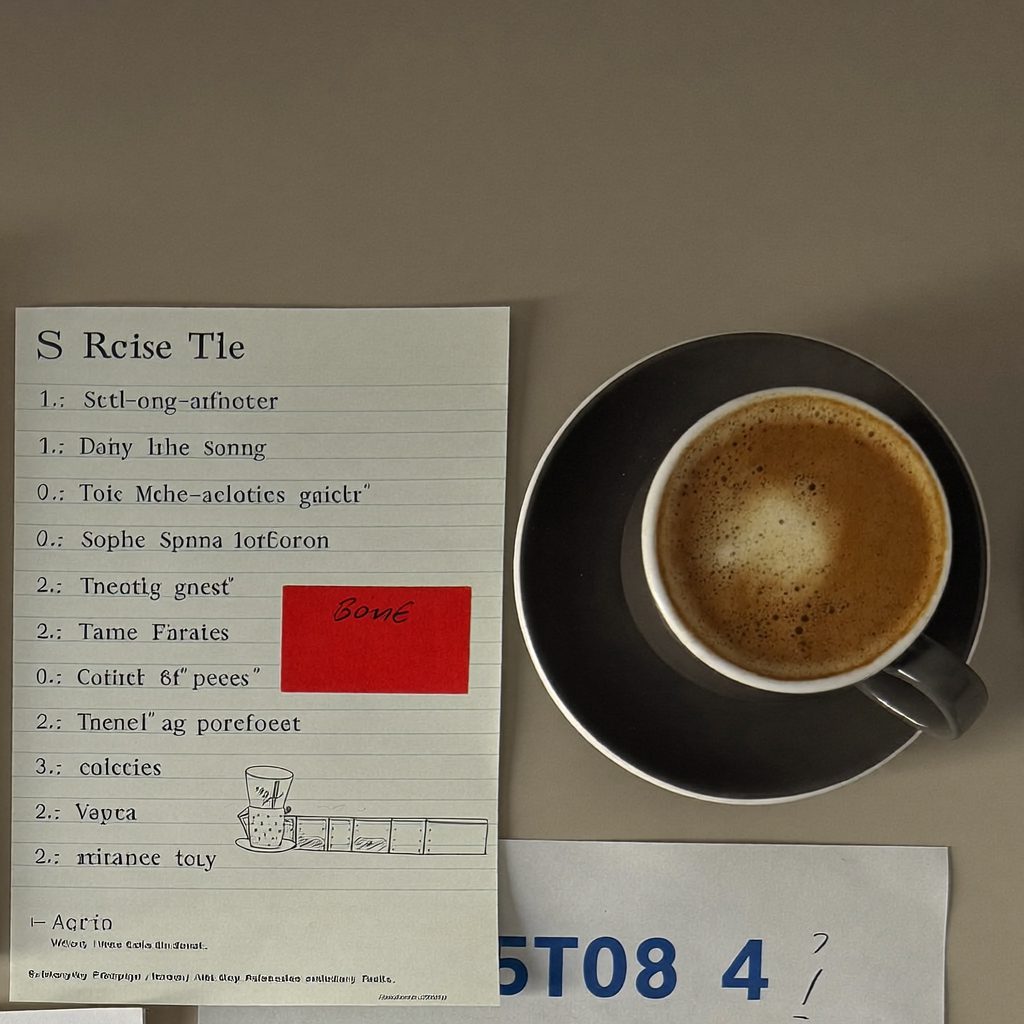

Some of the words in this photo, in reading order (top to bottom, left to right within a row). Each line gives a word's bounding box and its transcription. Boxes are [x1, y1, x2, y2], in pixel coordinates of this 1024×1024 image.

[37, 329, 63, 361] S
[188, 331, 246, 361] Tle
[80, 530, 146, 553] Sophe
[721, 938, 770, 1001] 4
